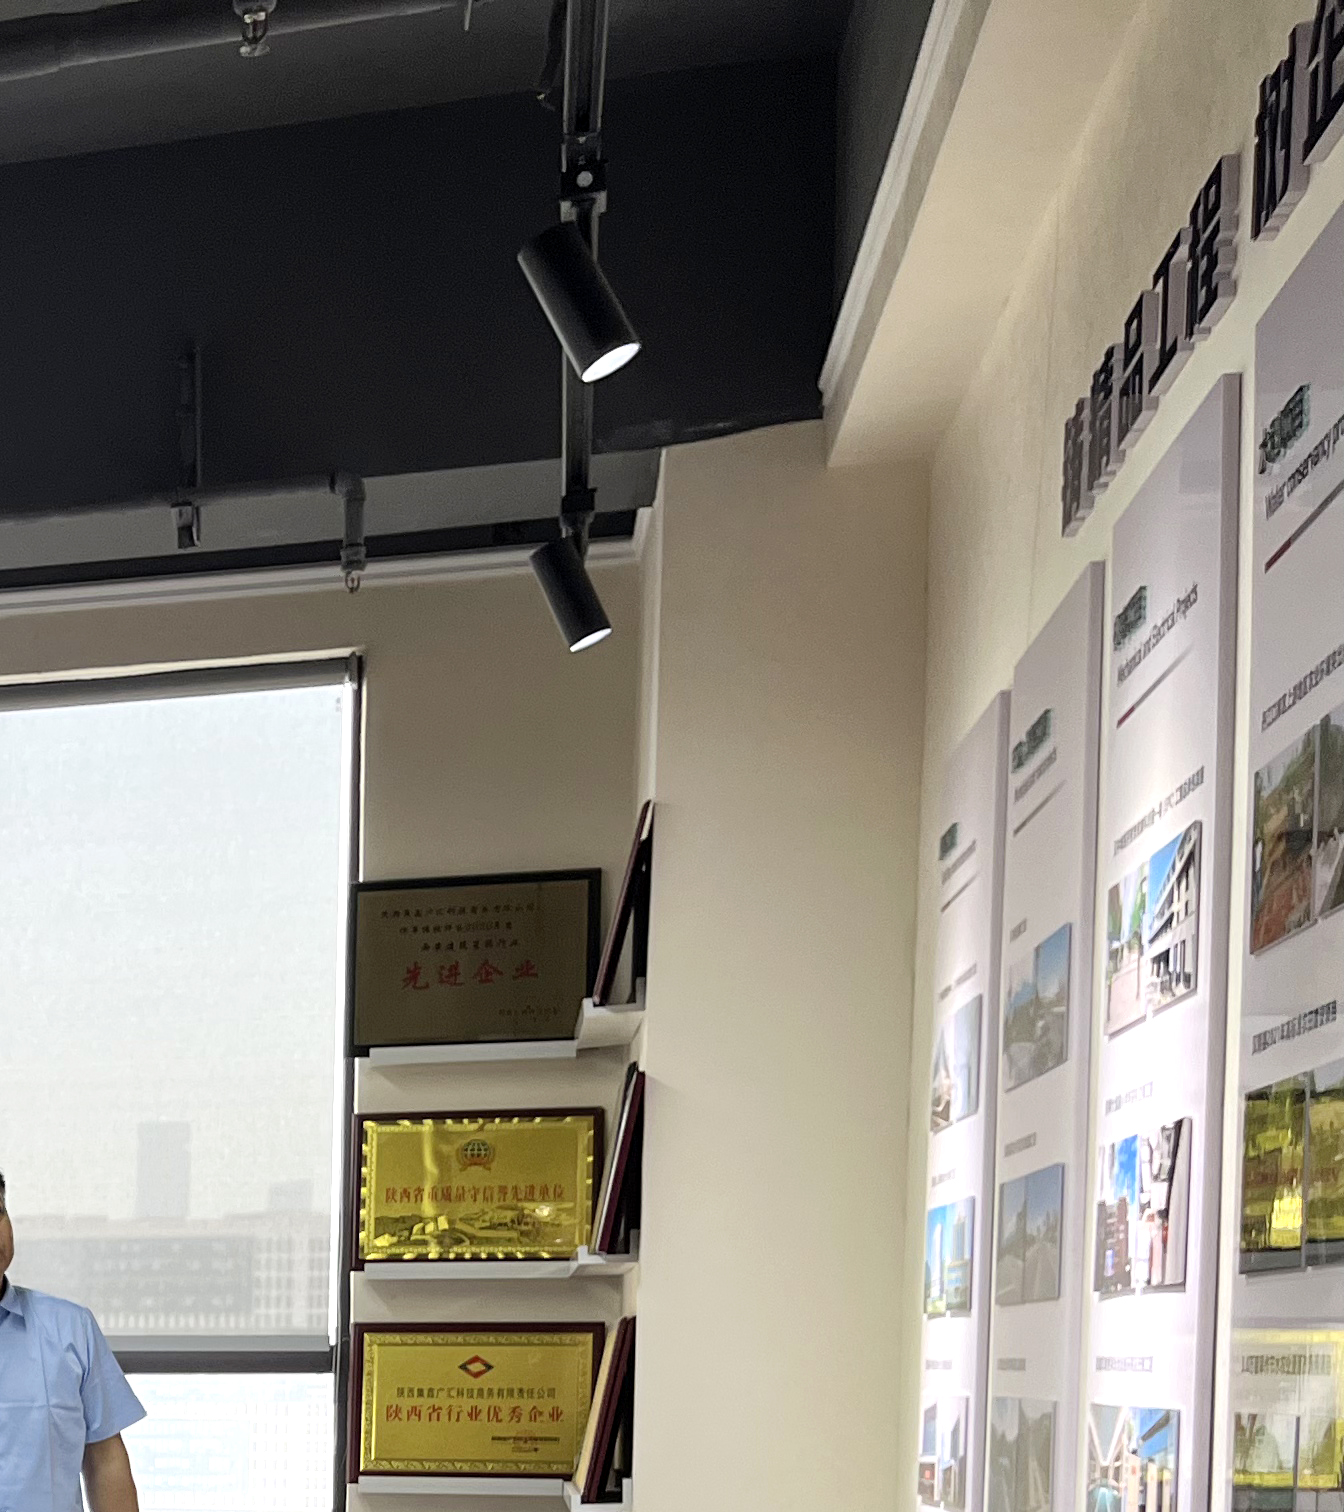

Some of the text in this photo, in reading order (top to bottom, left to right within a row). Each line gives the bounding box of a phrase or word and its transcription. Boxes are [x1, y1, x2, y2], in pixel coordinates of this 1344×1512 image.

[402, 959, 538, 991] 先进企业
[386, 1404, 565, 1424] 陕西省行业优秀企业
